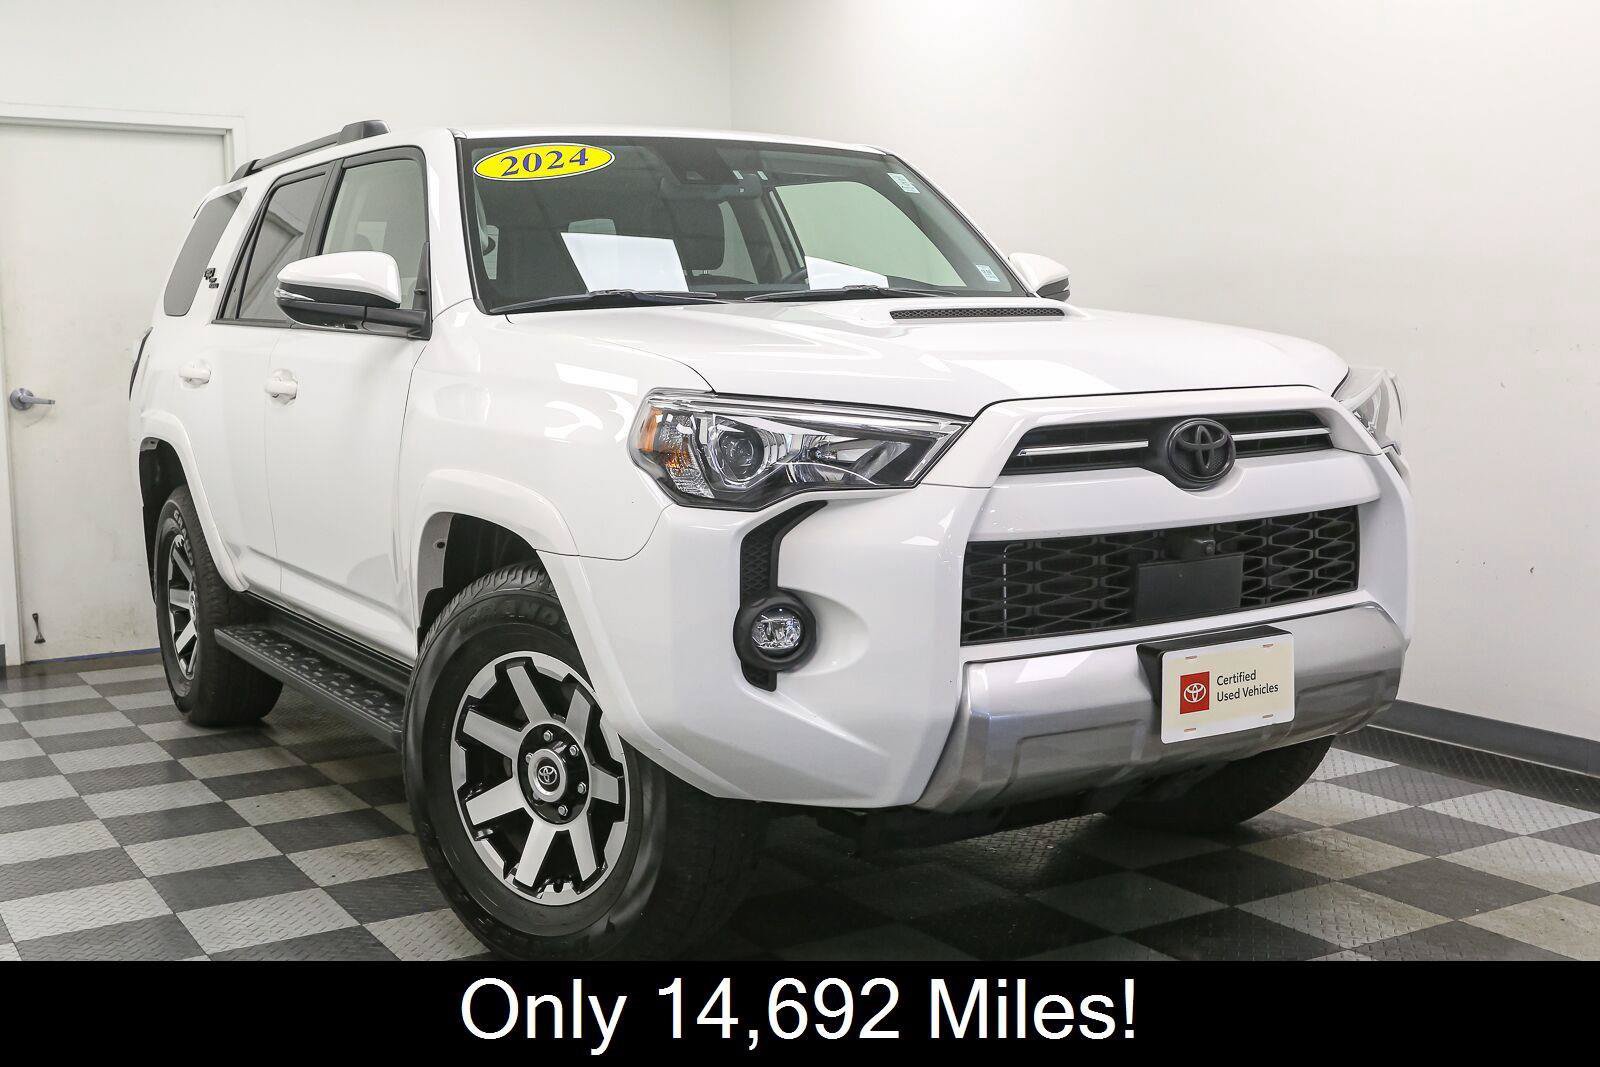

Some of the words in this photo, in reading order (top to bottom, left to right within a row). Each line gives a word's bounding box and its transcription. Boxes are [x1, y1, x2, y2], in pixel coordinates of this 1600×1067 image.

[500, 147, 589, 177] 2024
[1216, 669, 1257, 686] Certified
[1216, 688, 1241, 702] Used
[1242, 683, 1279, 698] Vehicles
